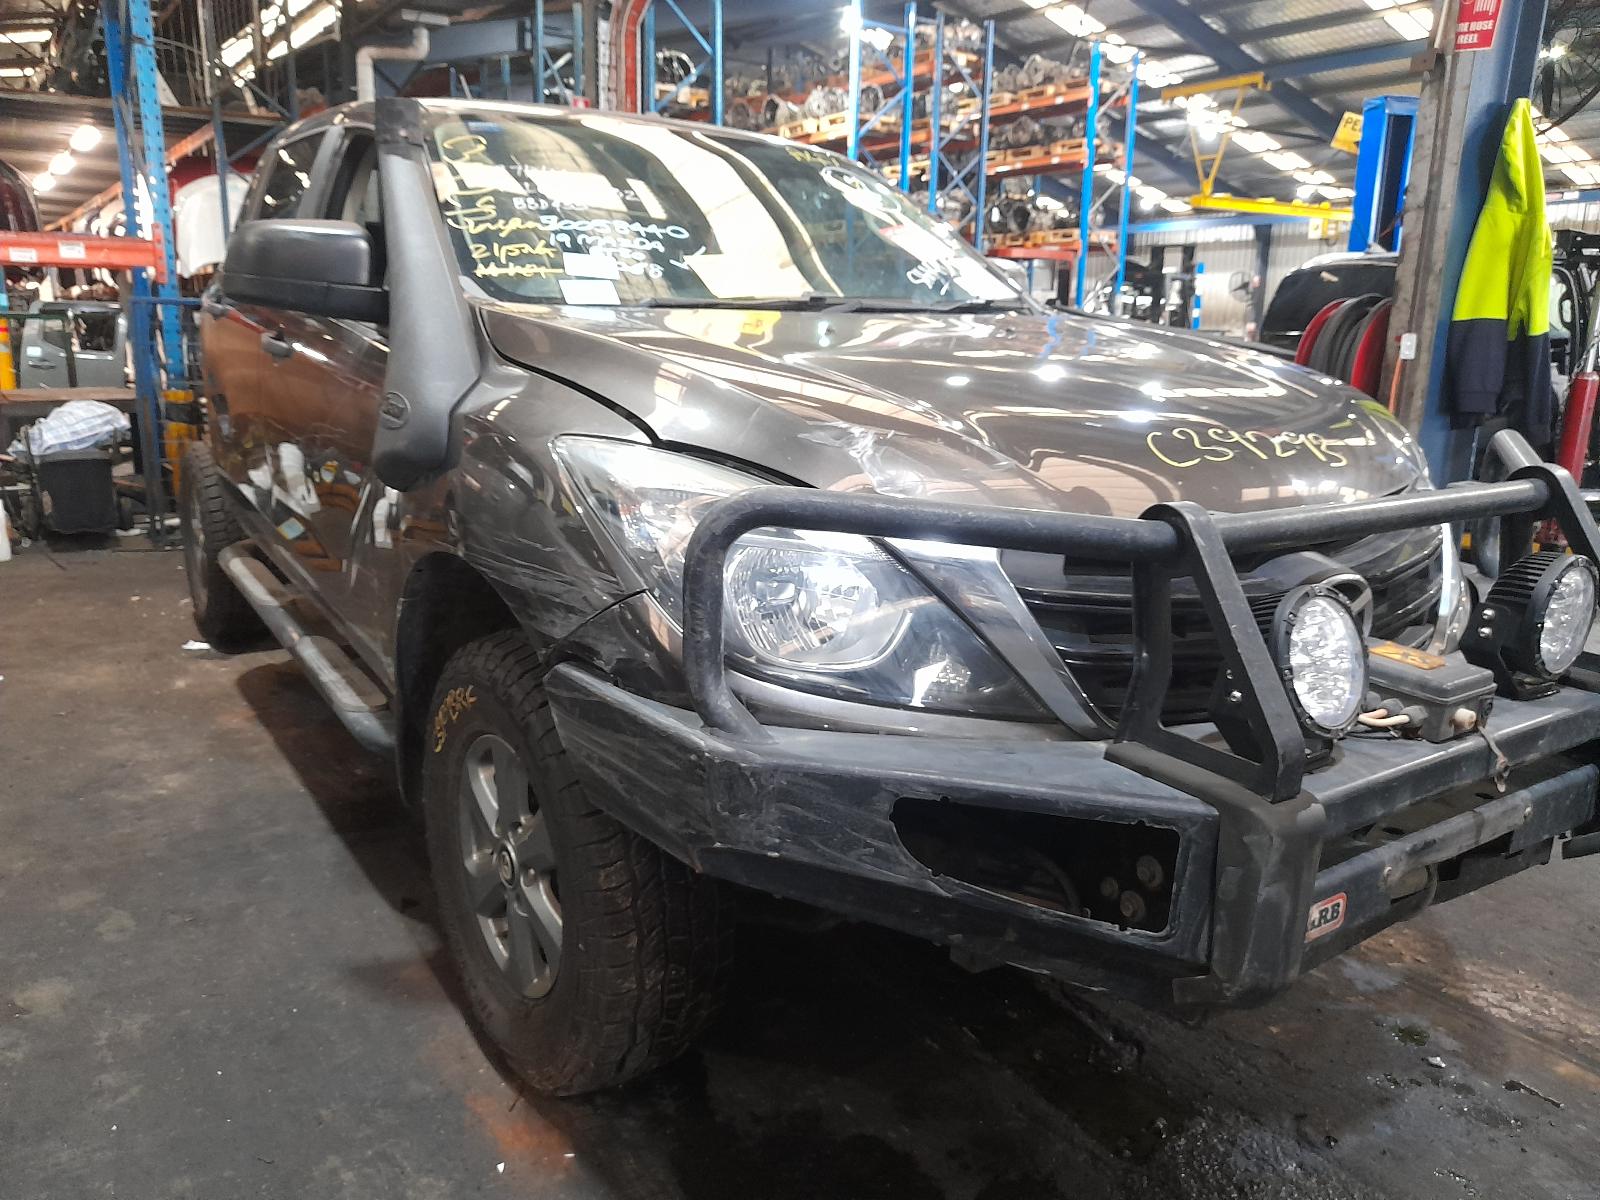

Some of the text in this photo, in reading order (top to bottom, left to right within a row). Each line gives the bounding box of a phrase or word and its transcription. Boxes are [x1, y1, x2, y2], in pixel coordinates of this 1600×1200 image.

[1469, 19, 1494, 31] HOSE
[1456, 33, 1478, 44] REEL
[1343, 116, 1361, 132] PE
